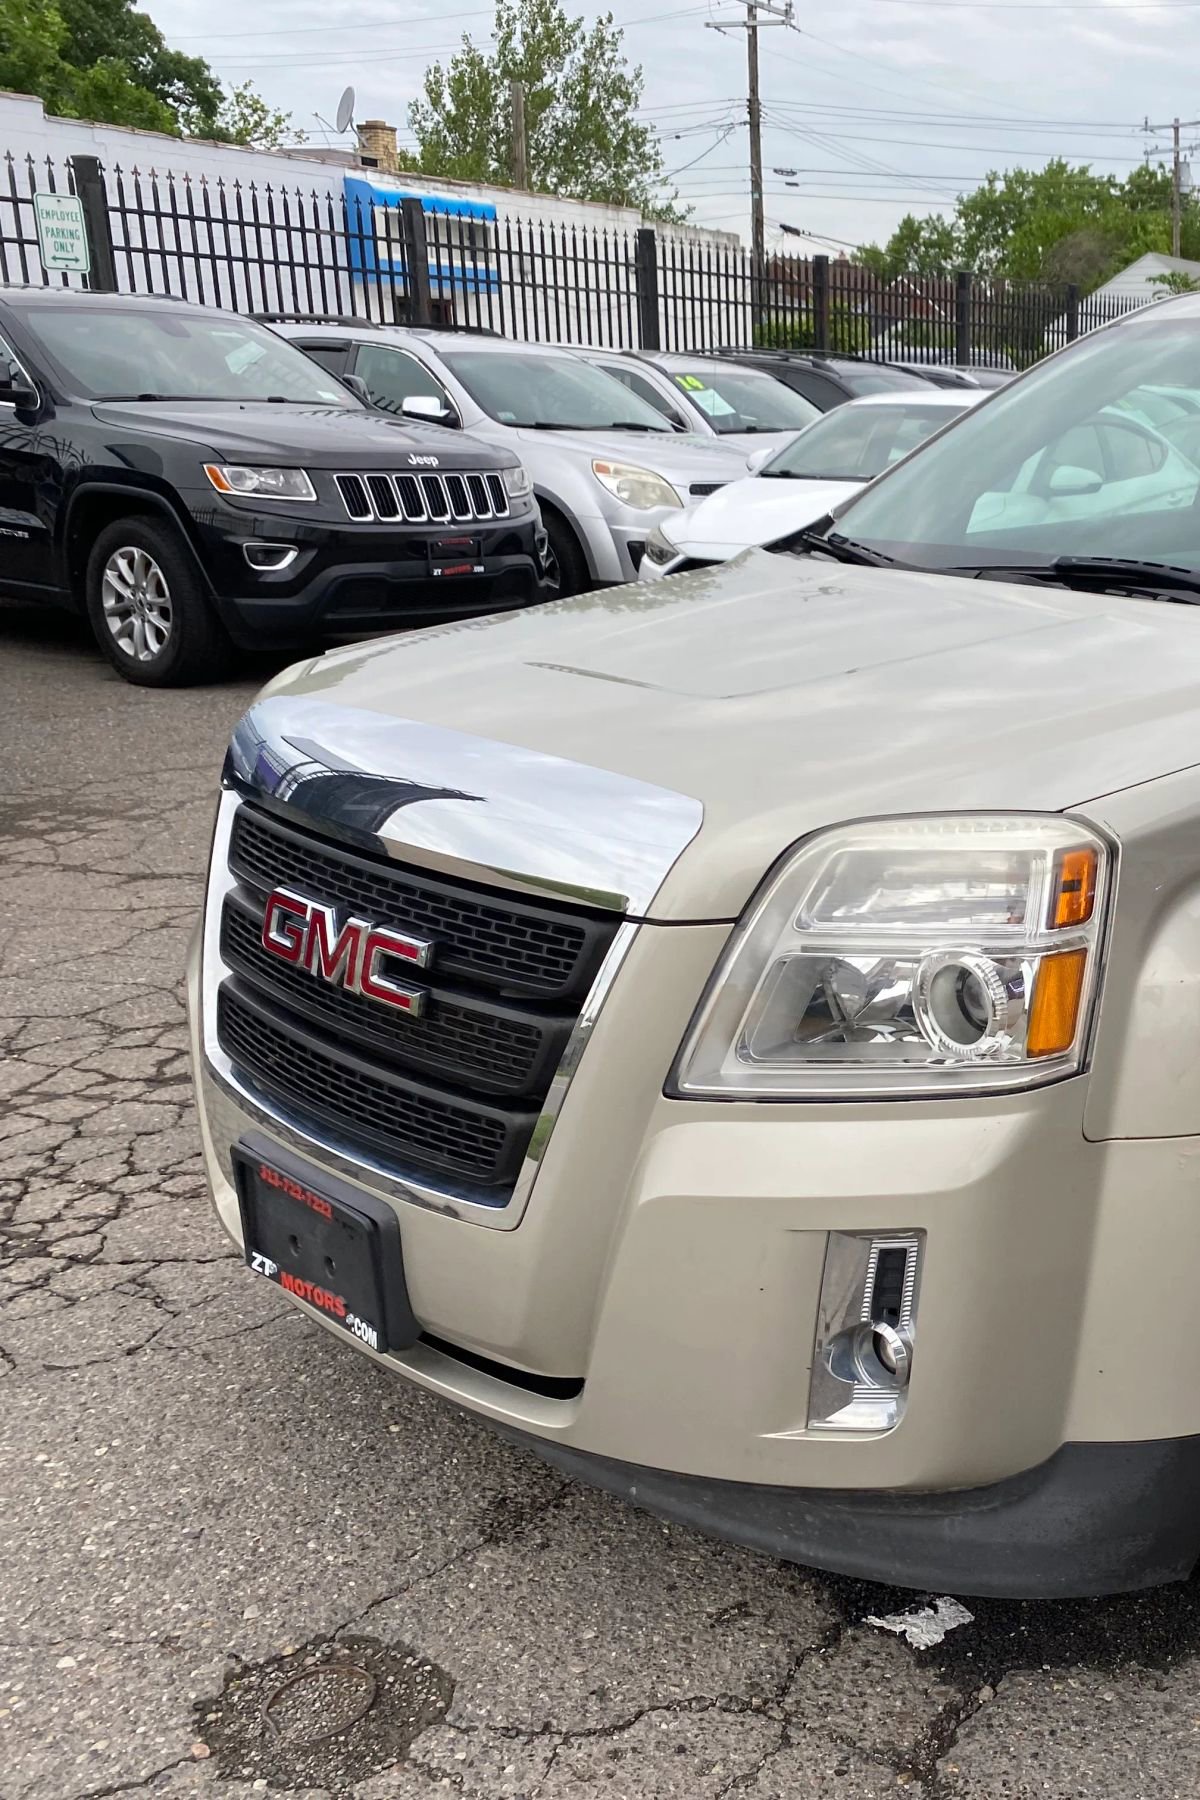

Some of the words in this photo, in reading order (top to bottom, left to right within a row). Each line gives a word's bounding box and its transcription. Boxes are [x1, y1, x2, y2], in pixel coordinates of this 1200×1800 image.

[40, 208, 79, 222] EMPLOYEE
[45, 226, 80, 240] PARKING
[53, 241, 75, 253] ONLY
[408, 453, 439, 467] Jeep
[262, 886, 434, 1017] GMC
[280, 1271, 347, 1317] MOTORS
